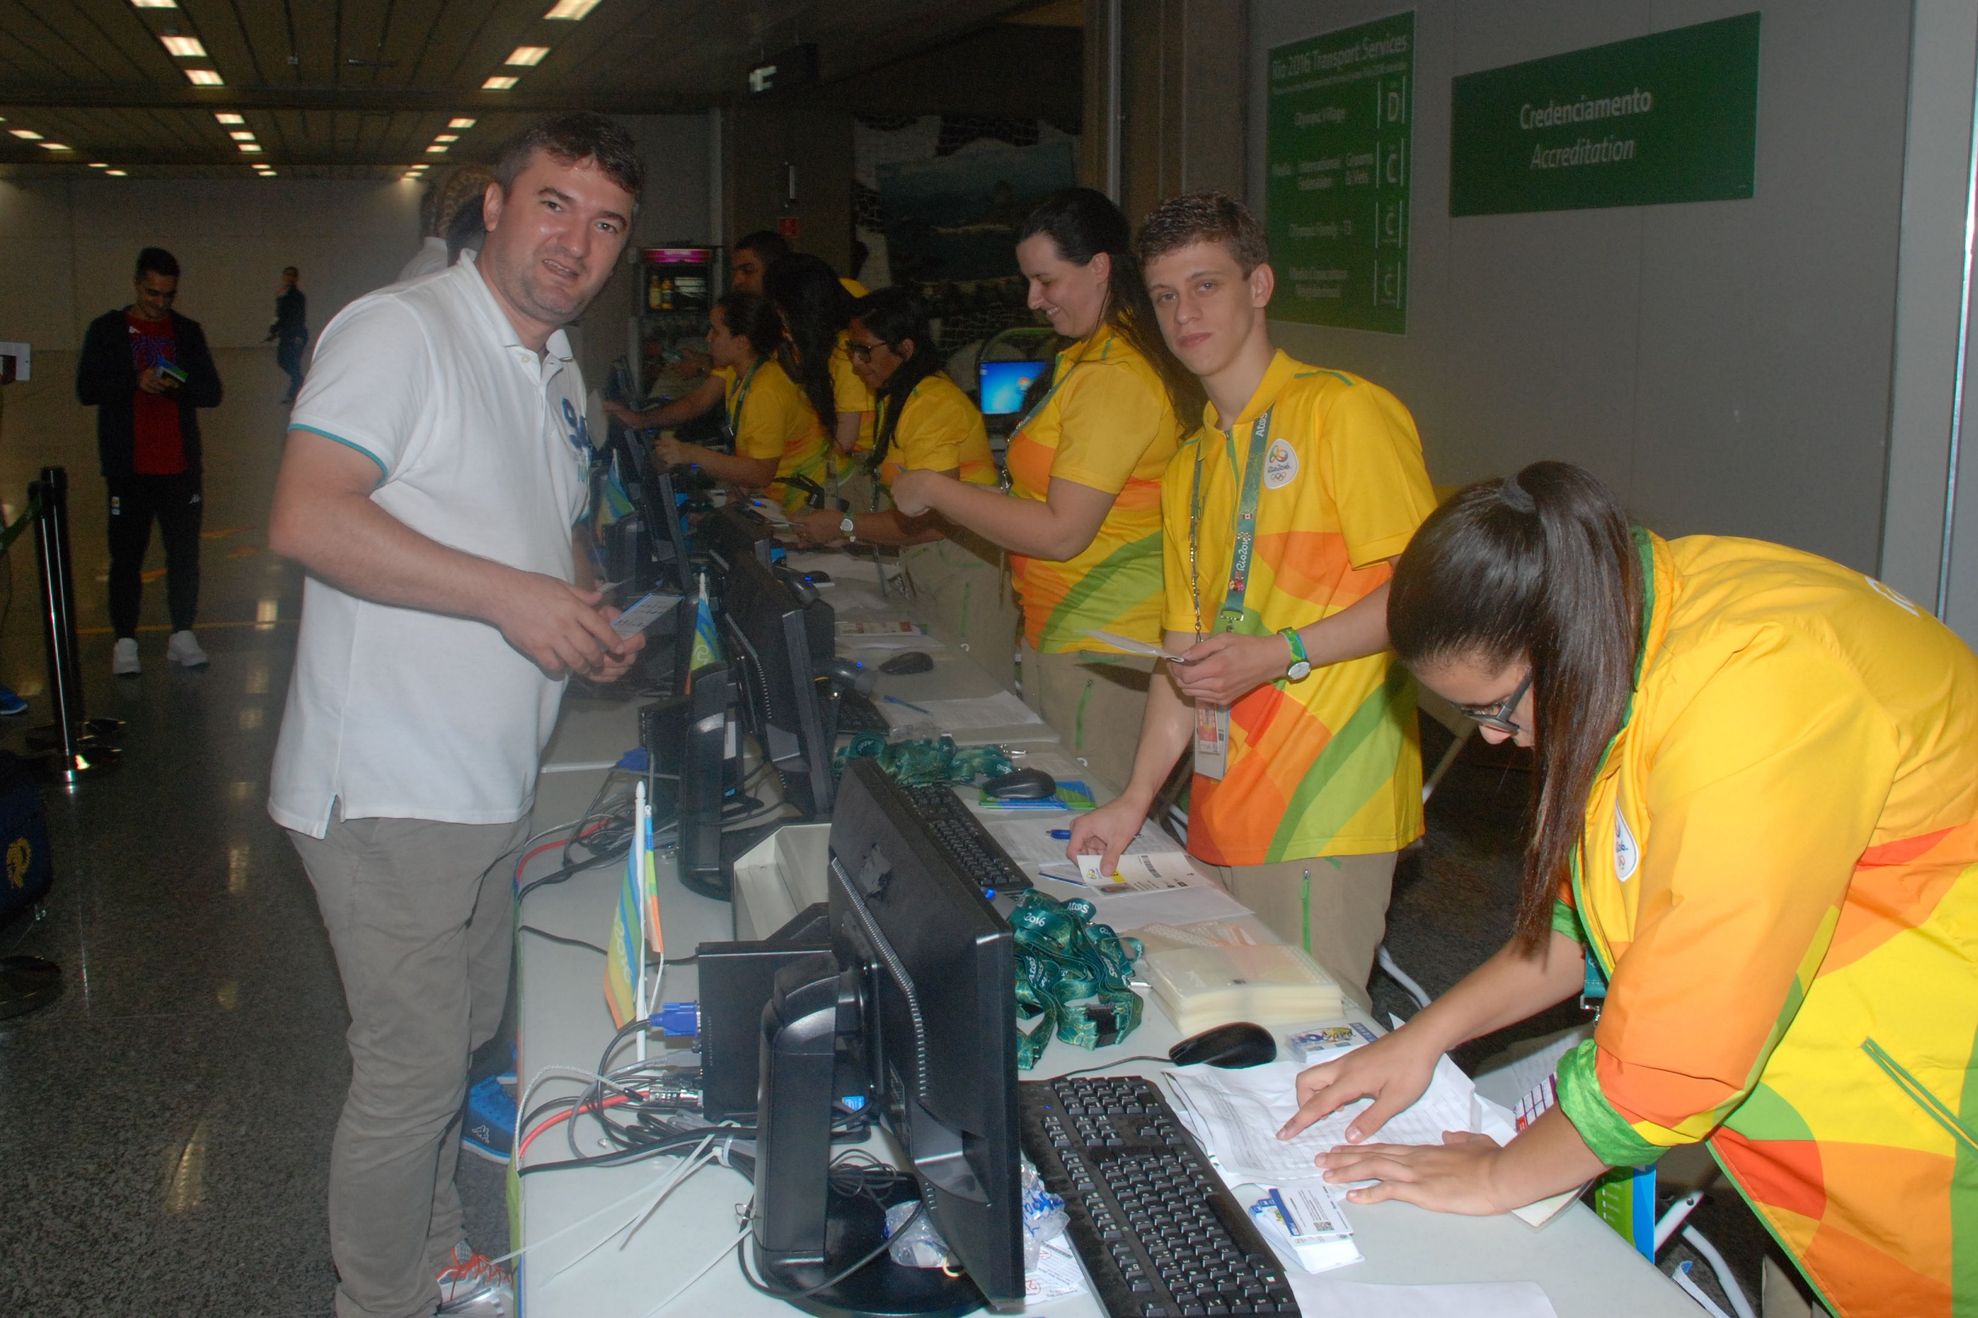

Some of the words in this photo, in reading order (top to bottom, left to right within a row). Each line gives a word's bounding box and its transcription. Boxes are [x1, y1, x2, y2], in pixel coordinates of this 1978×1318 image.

[1362, 33, 1409, 59] Services
[1387, 91, 1399, 122] D
[1519, 86, 1652, 130] Credenciamento
[1529, 134, 1636, 170] Accreditation
[1024, 912, 1046, 927] 2016
